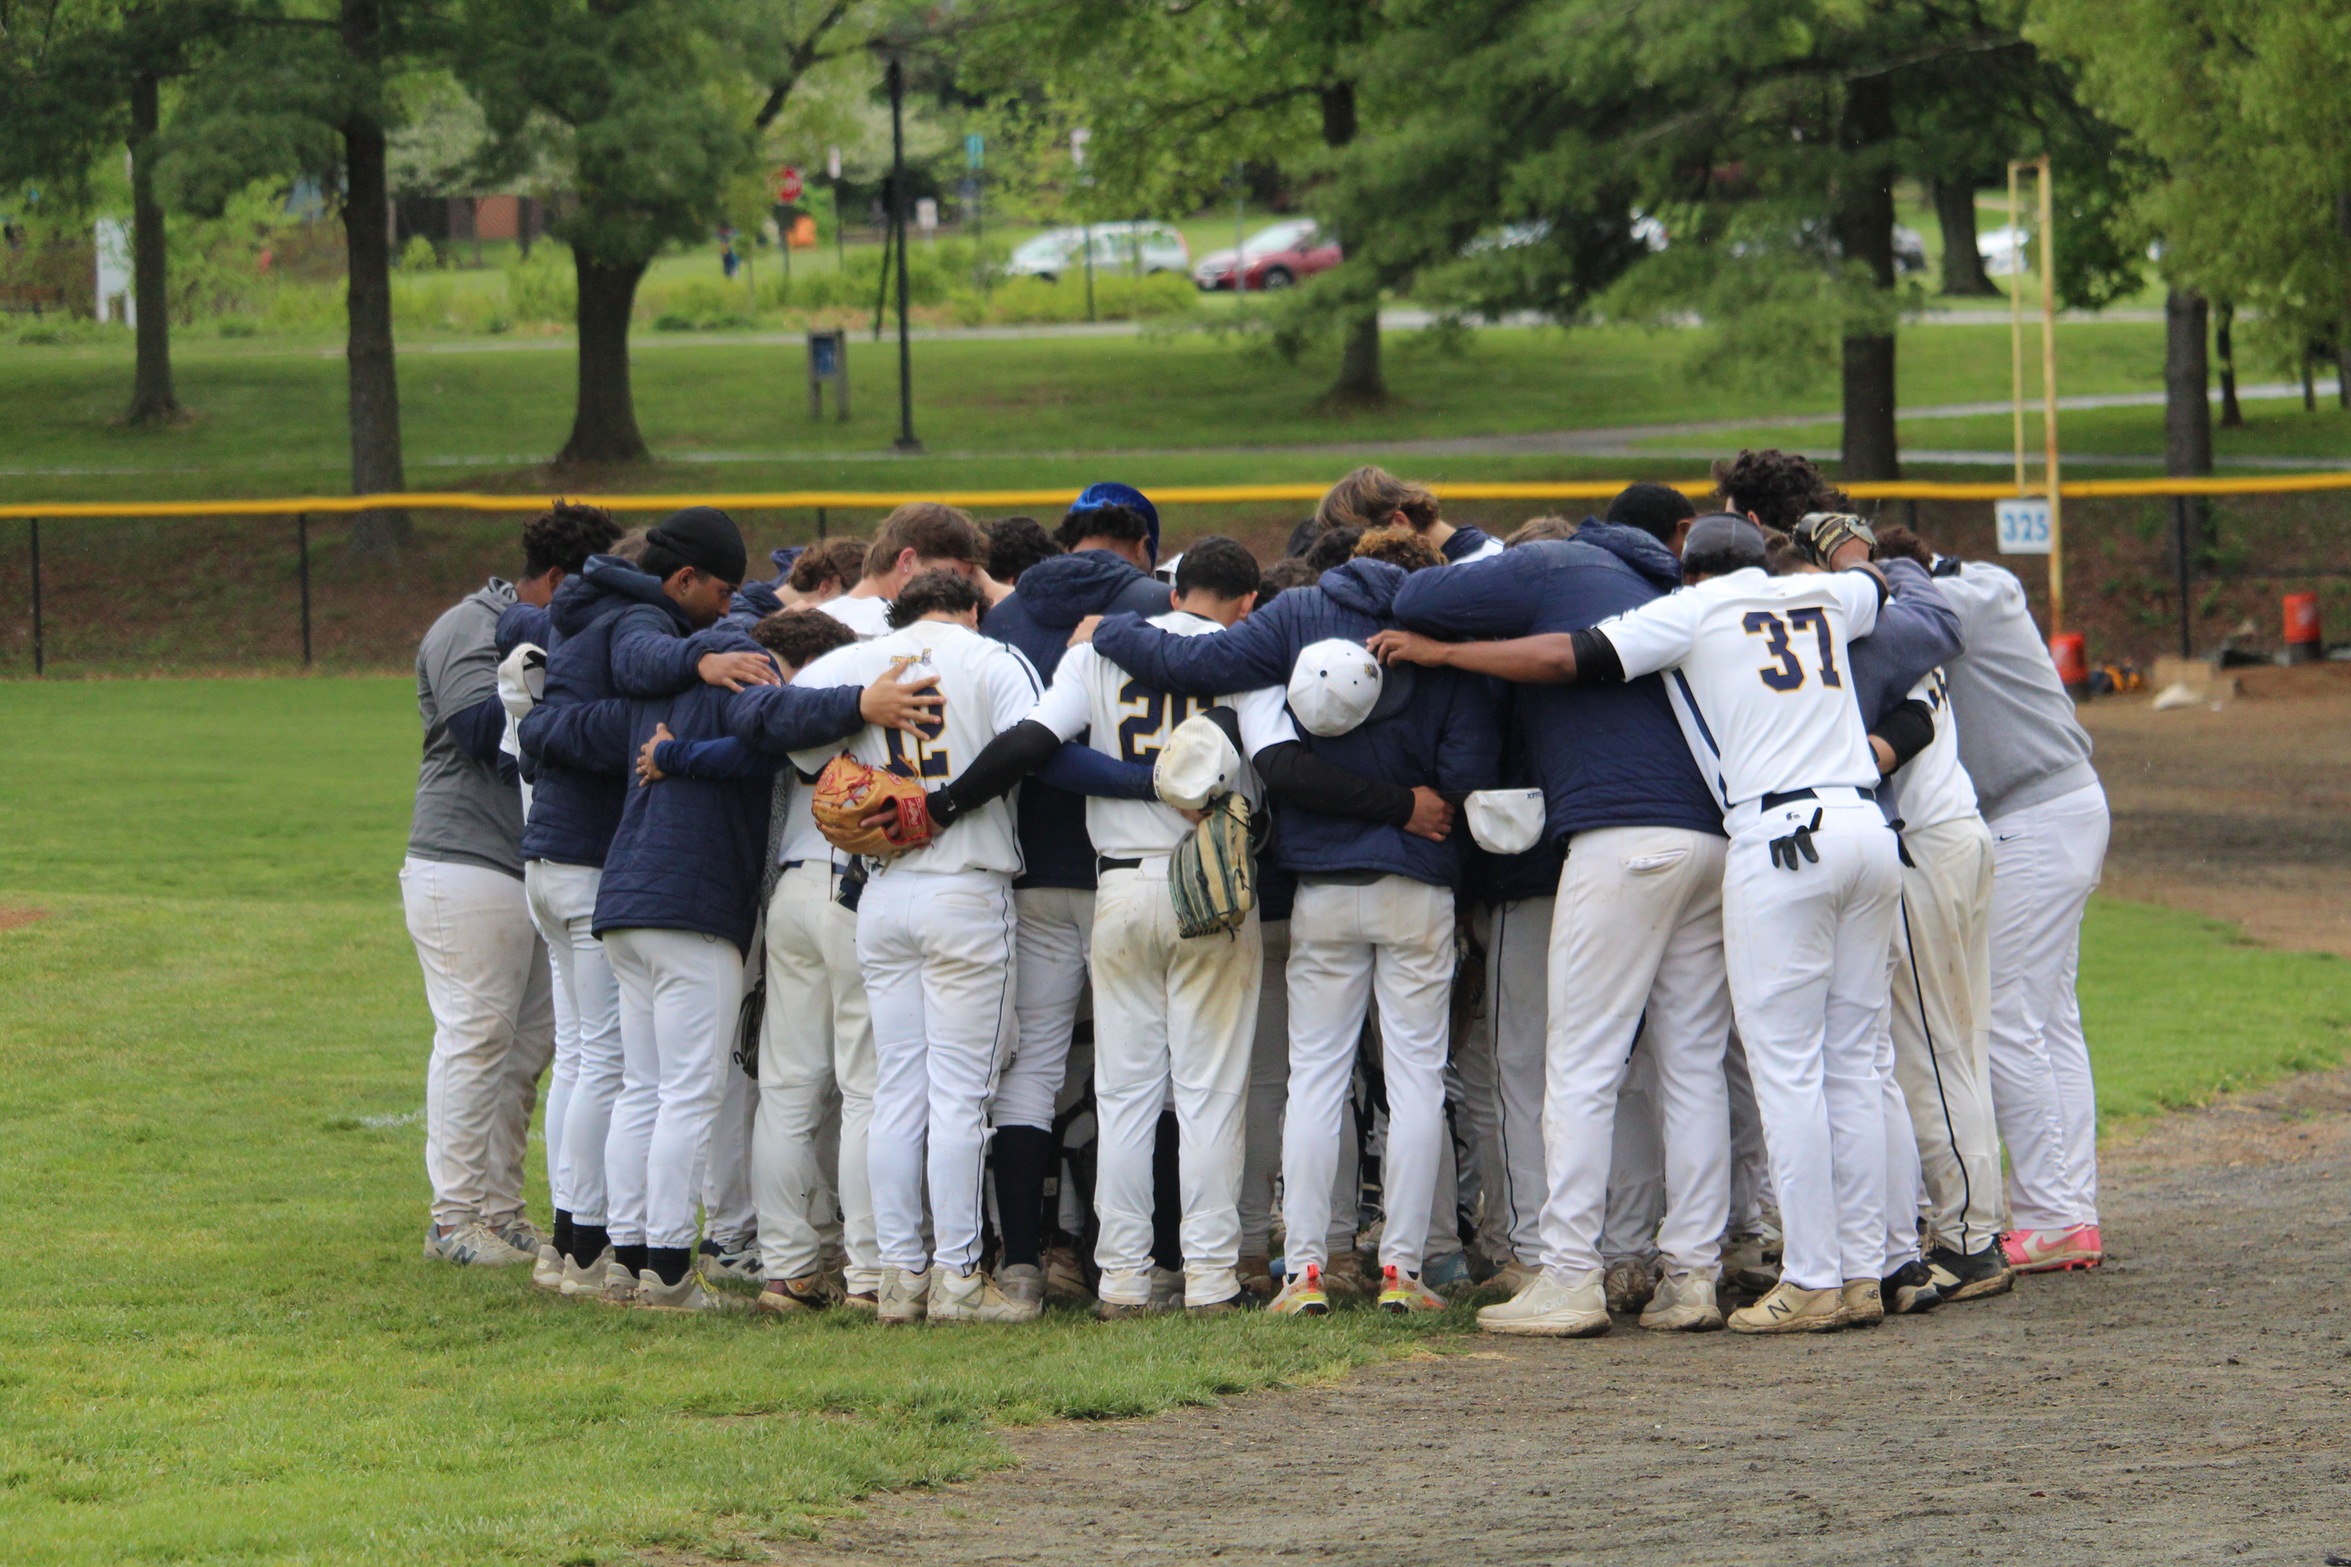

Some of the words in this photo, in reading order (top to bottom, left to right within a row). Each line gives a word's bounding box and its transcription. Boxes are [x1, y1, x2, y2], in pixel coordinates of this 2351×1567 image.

[2003, 512, 2049, 541] 325
[1742, 606, 1843, 694] 37
[1534, 1294, 1569, 1315] HOKA
